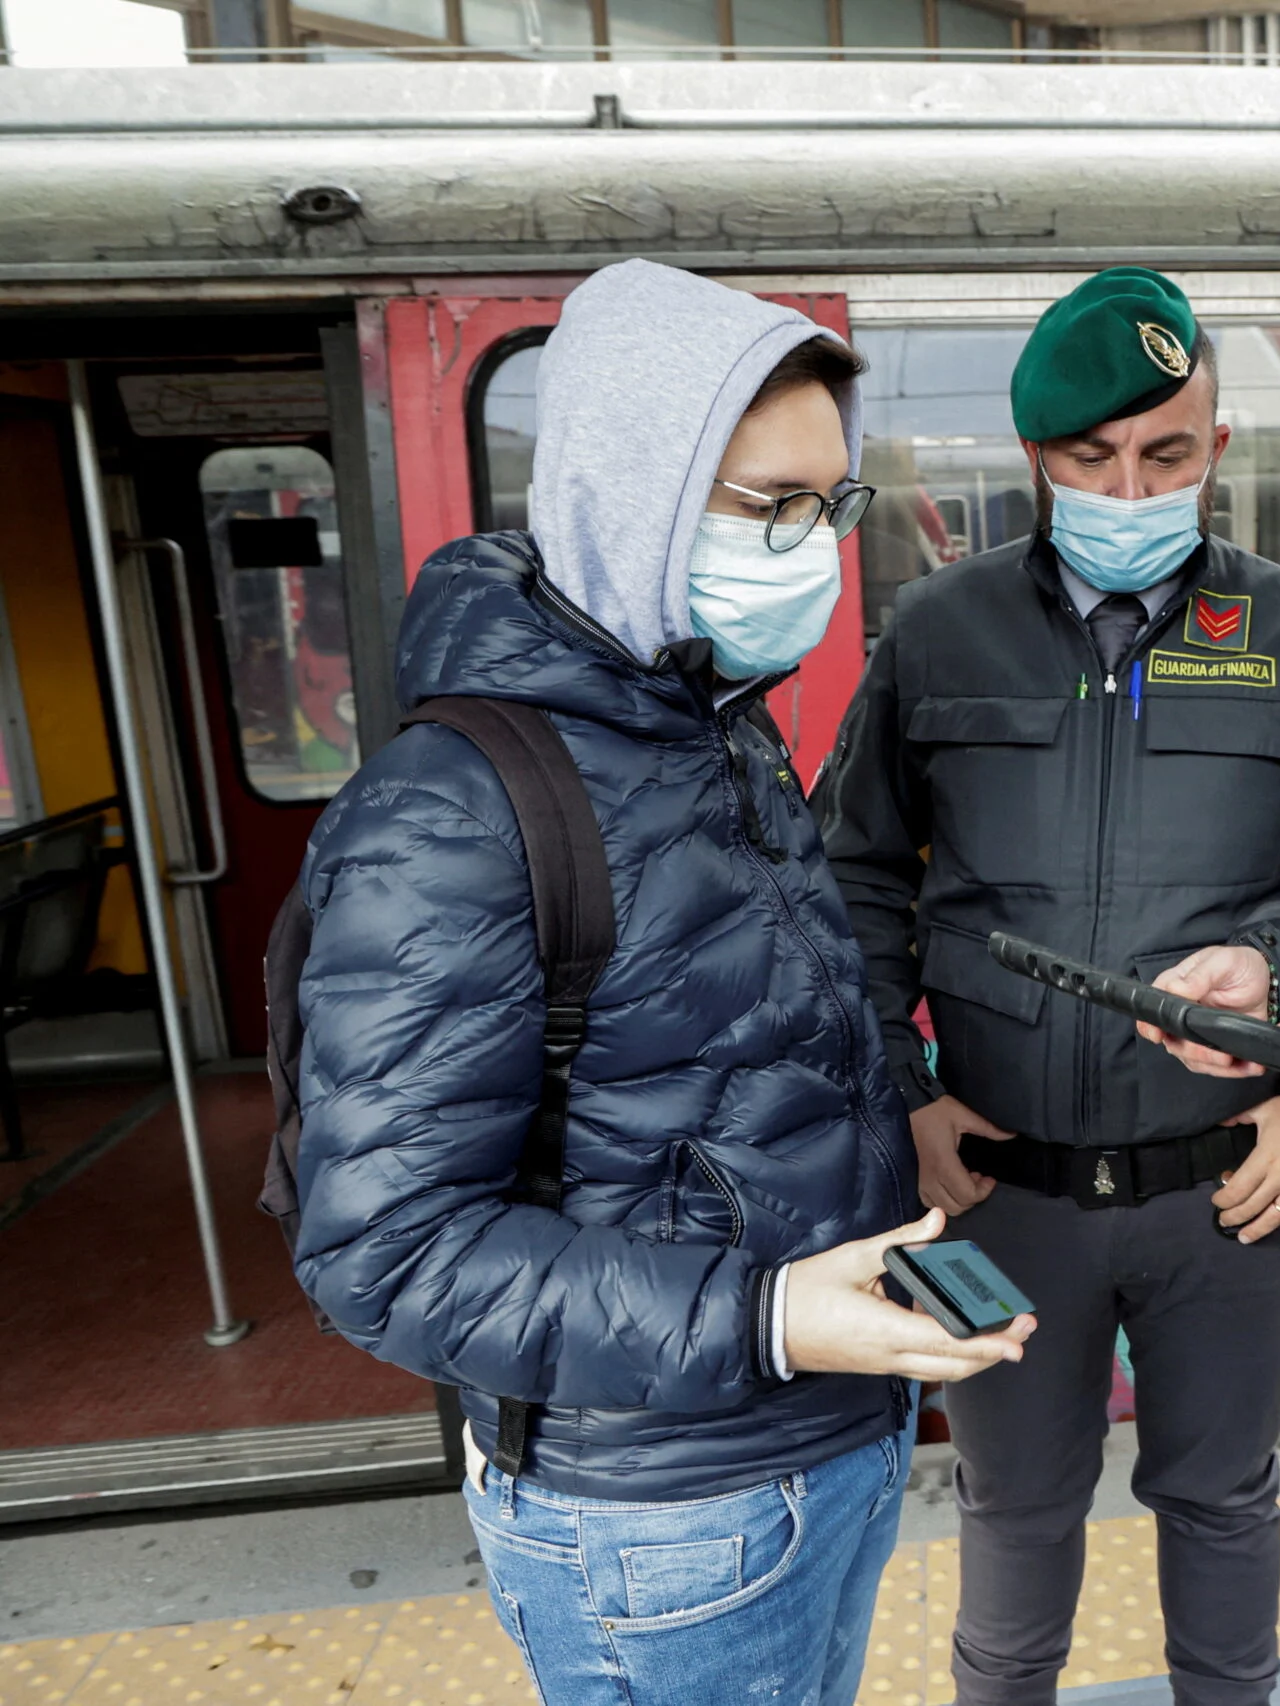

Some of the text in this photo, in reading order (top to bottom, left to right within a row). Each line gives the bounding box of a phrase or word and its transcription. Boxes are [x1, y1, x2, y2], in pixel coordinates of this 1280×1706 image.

[1154, 659, 1269, 679] GUARDIA di FINANZA
